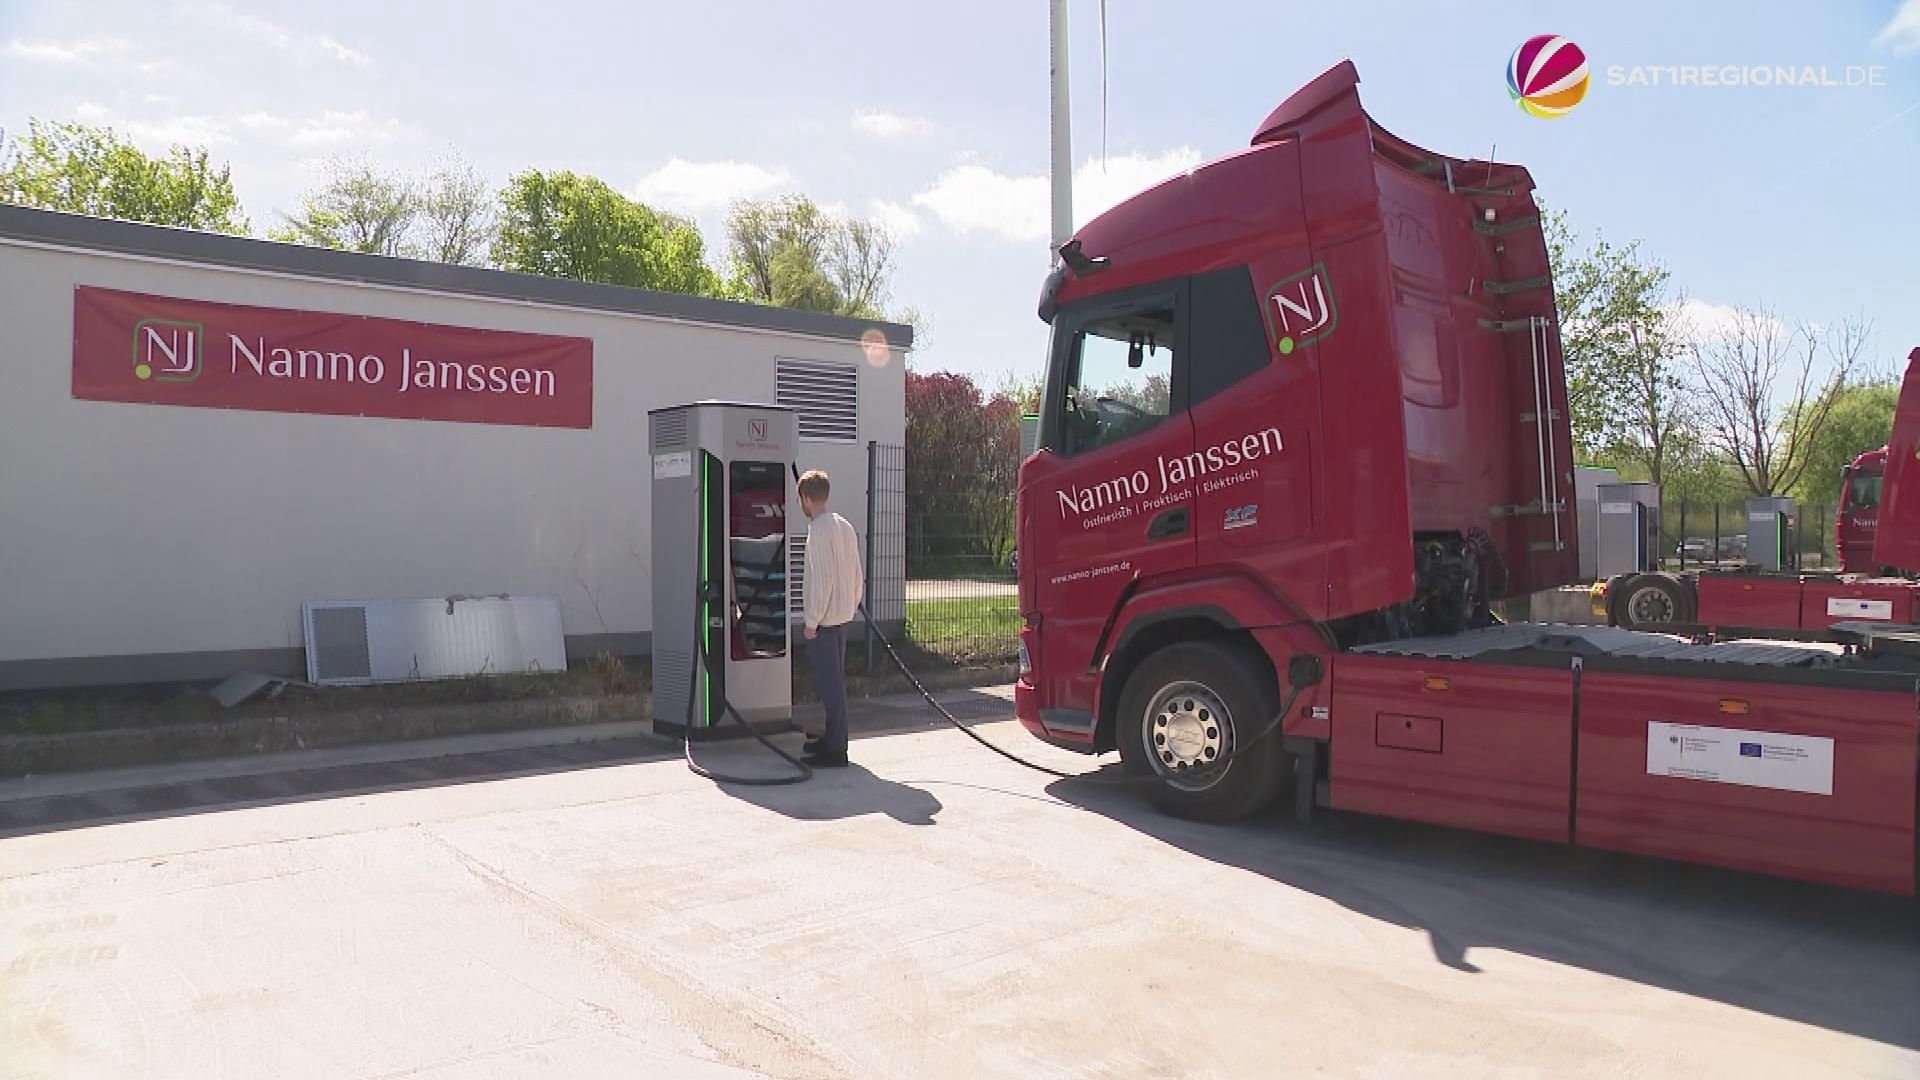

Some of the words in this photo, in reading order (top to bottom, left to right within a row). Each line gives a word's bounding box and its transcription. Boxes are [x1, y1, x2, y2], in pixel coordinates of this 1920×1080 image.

[1271, 274, 1329, 335] NJ
[143, 327, 194, 372] NJ
[229, 334, 385, 384] Nanno
[400, 348, 555, 397] Janssen
[1056, 470, 1150, 520] Nanno
[1157, 426, 1284, 493] Janssen
[1083, 506, 1132, 530] Ostfriesisch
[1143, 488, 1192, 512] Praktisch
[1203, 468, 1259, 493] Elektrisch
[1050, 561, 1131, 585] www.nanno-janssen.de
